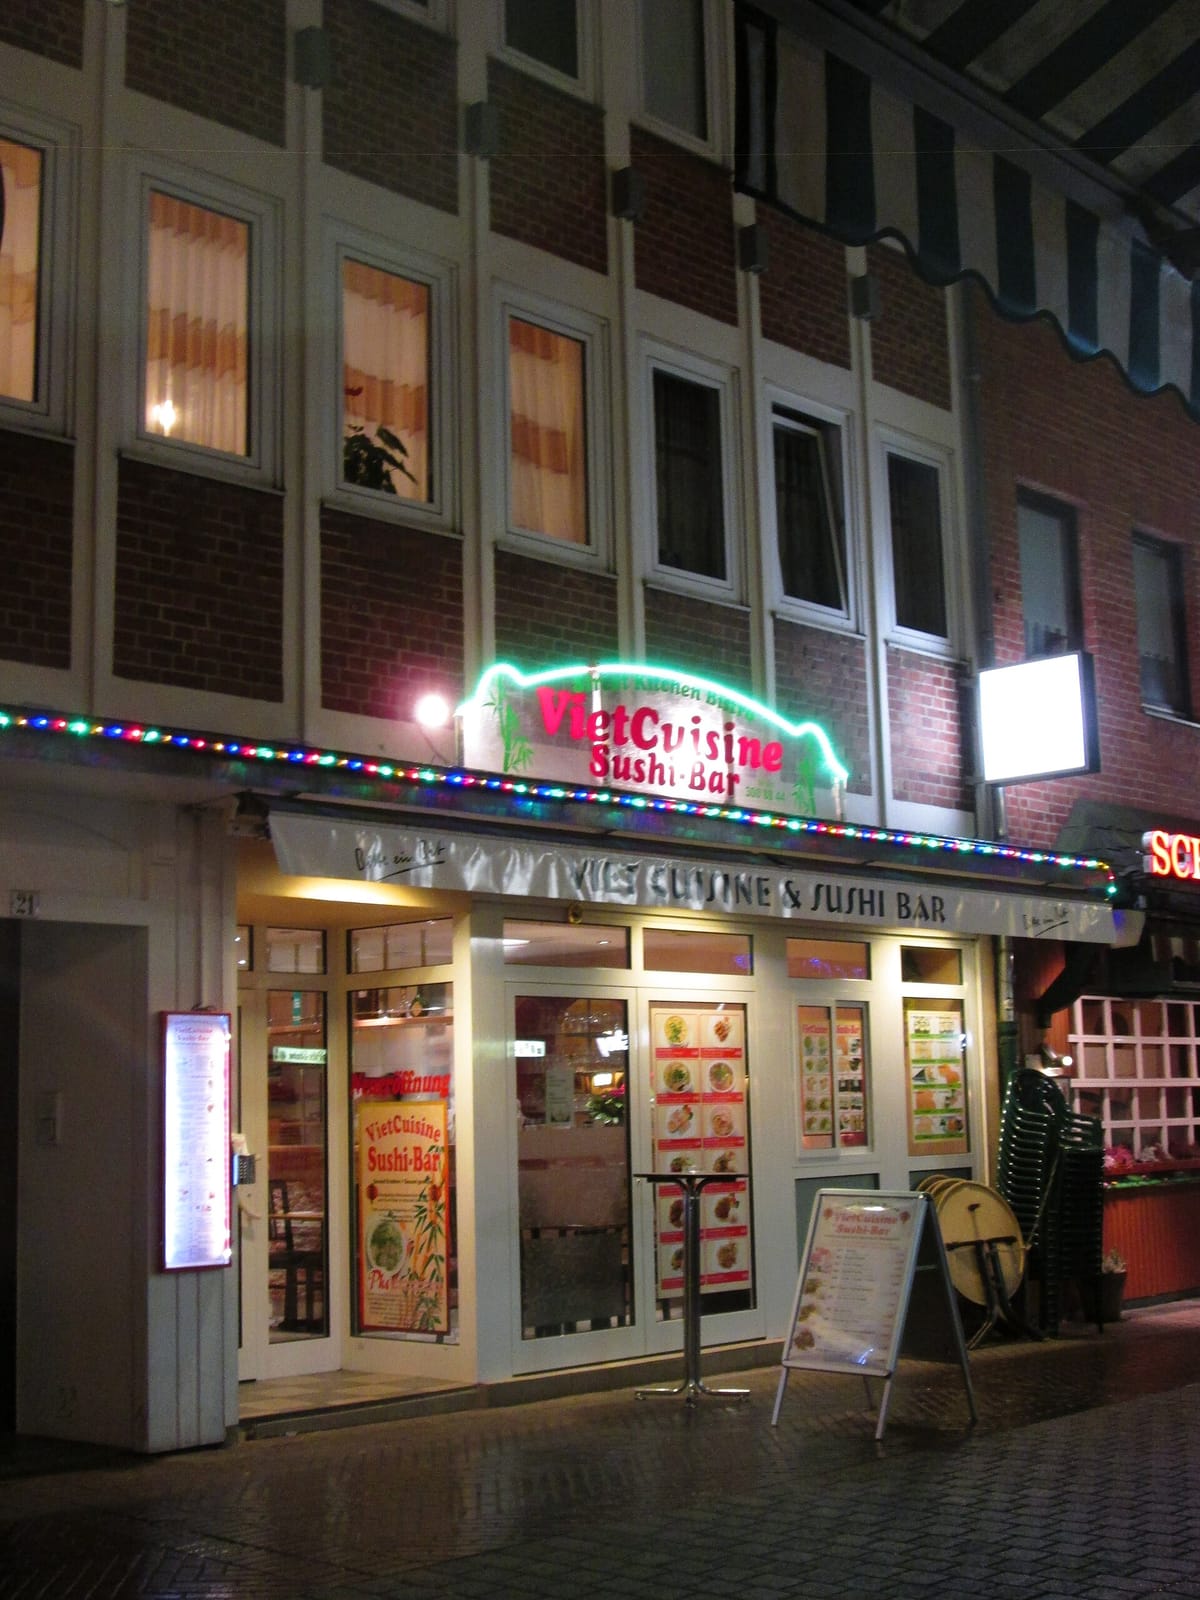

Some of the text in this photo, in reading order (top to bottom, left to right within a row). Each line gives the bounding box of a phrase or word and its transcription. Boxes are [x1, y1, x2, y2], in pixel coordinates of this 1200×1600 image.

[536, 686, 784, 773] VietCuisine
[566, 856, 946, 923] VIET CUISINE & SUSHI BAR
[15, 894, 34, 915] 21
[365, 1114, 441, 1142] VietCuisine
[367, 1145, 440, 1172] Sushi-Bar
